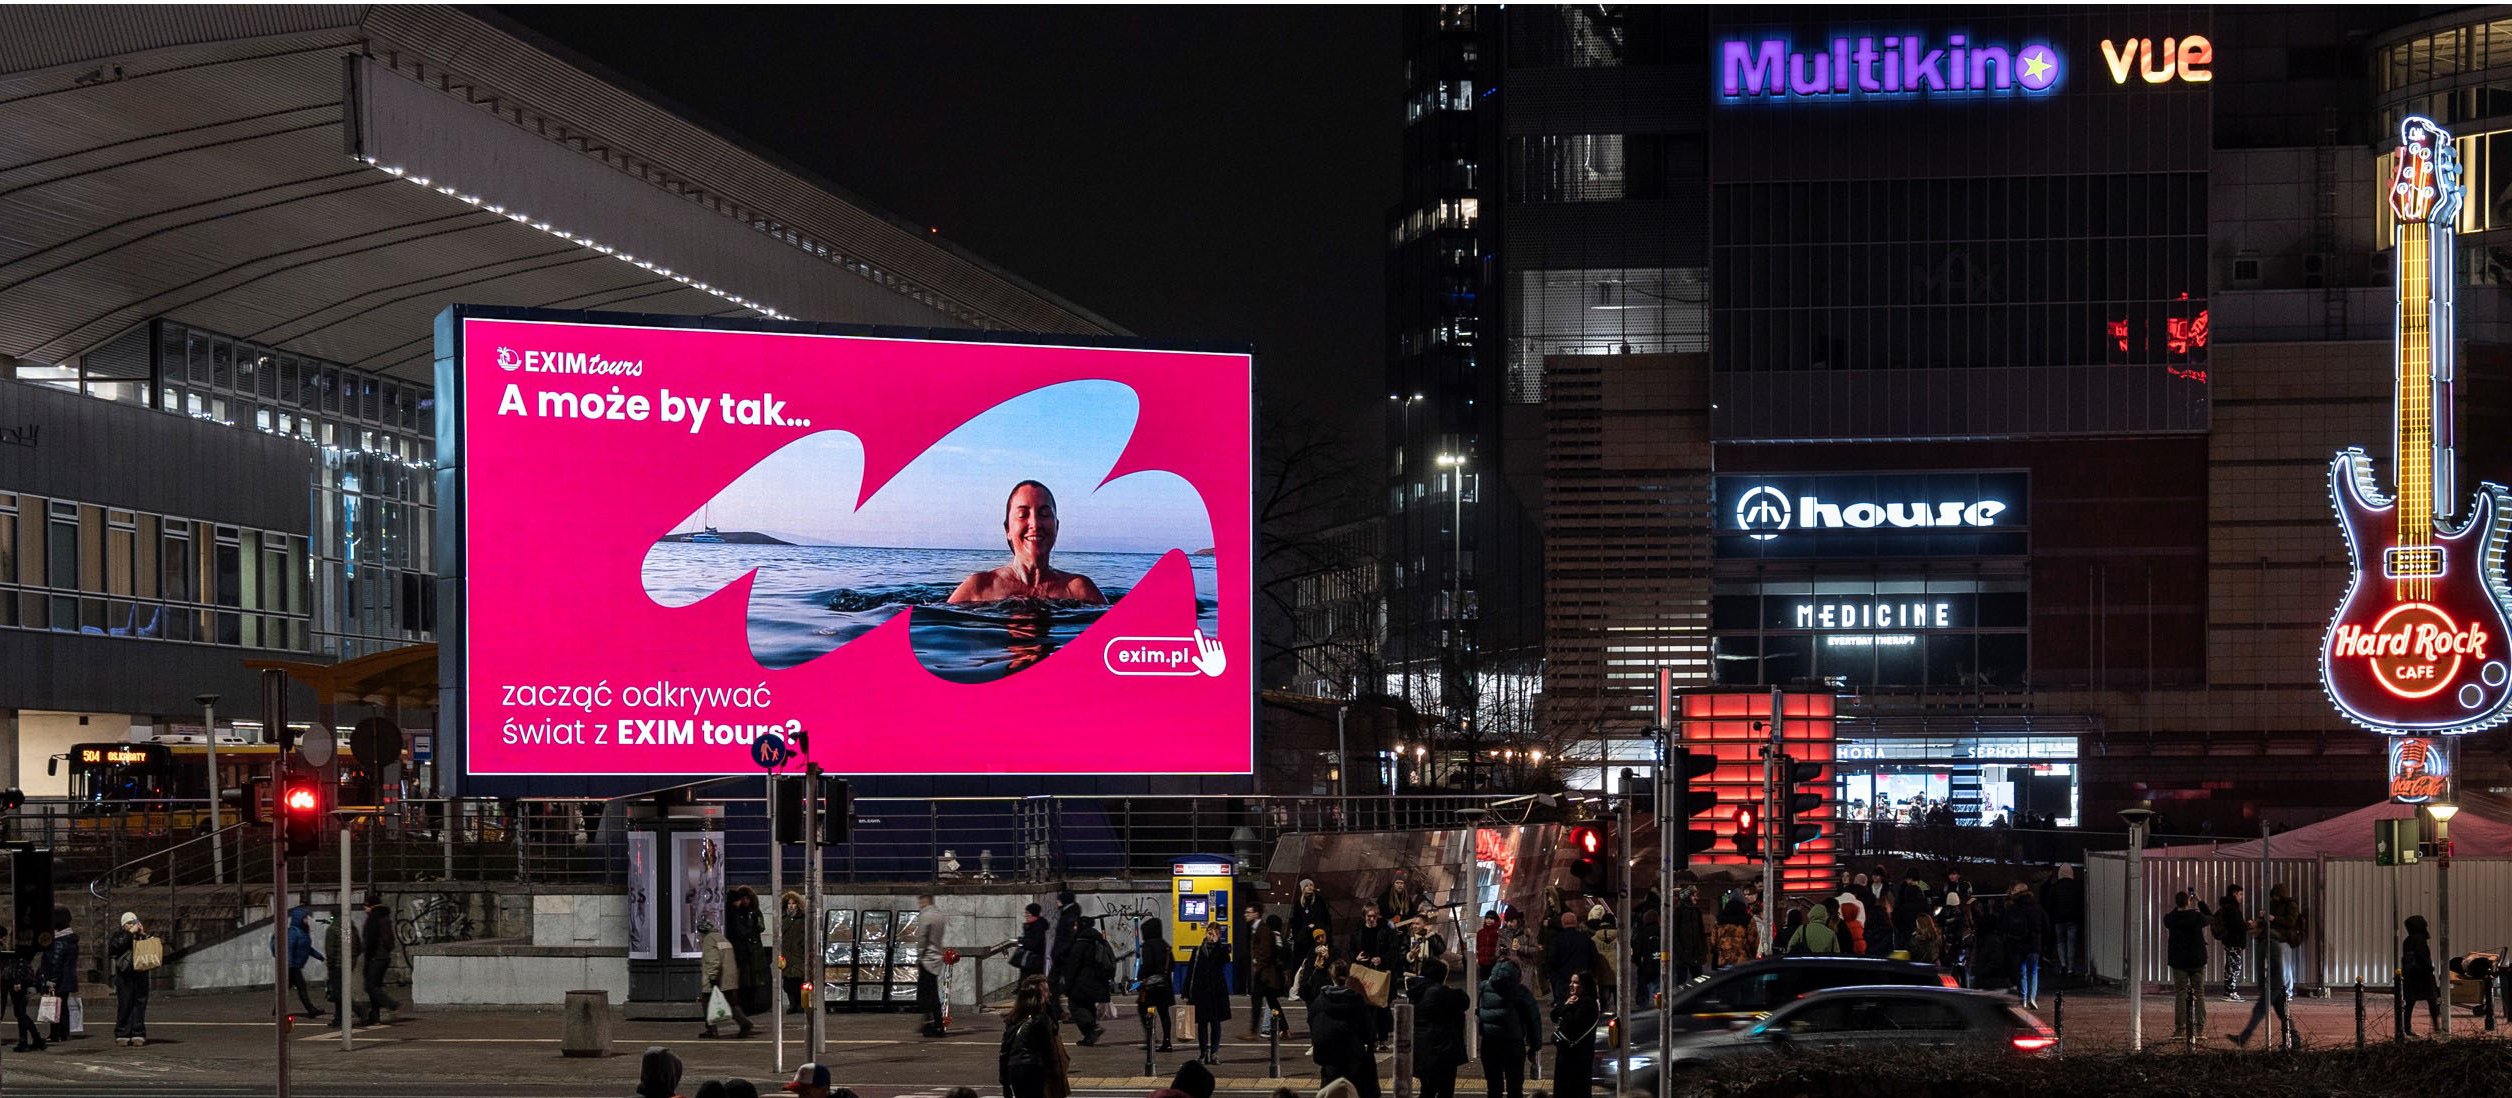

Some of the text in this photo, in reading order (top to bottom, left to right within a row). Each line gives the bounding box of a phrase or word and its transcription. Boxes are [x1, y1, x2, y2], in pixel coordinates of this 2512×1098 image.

[1723, 34, 2060, 97] Multikino
[2101, 35, 2213, 84] vue
[498, 384, 811, 433] A może by tak...
[1799, 496, 2007, 527] house
[1797, 603, 1949, 627] MEDICINE
[1119, 646, 1189, 666] exim.pl
[2336, 622, 2488, 661] Hard Rock
[2396, 665, 2435, 680] CAFE
[503, 680, 771, 715] zacząć odkrywać
[503, 716, 586, 745] świat
[595, 726, 608, 745] z
[618, 718, 695, 745] EXIM
[83, 750, 100, 762] 504
